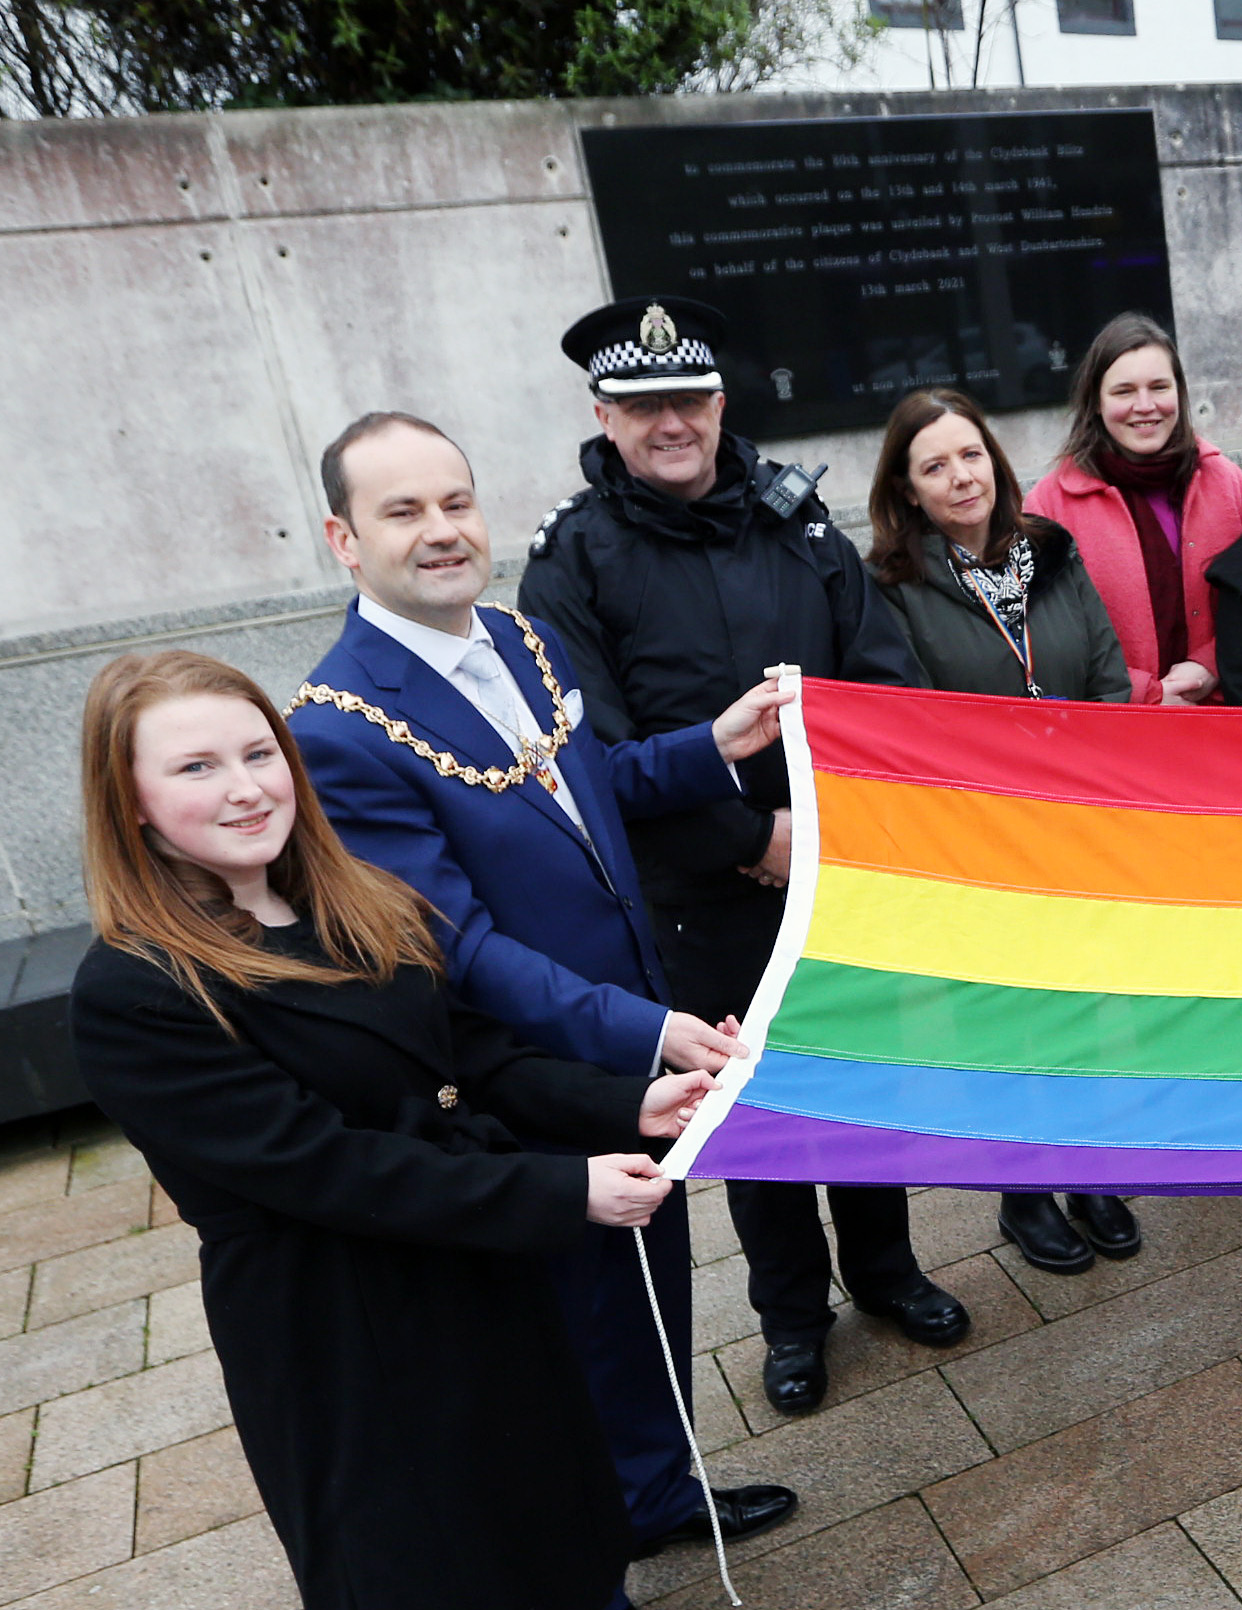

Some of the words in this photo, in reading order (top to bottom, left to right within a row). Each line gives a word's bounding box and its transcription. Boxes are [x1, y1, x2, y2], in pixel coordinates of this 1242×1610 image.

[707, 159, 797, 175] commemorate
[803, 157, 824, 168] the
[868, 152, 936, 166] anniversary
[944, 150, 957, 163] of
[964, 149, 983, 161] the
[990, 144, 1049, 161] Clydebank
[1057, 144, 1084, 157] Blitz
[728, 192, 766, 207] which
[775, 188, 829, 204] occurred
[837, 190, 853, 200] on
[861, 186, 880, 198] the
[889, 184, 915, 197] 13th
[922, 184, 944, 195] and
[952, 181, 977, 194] 14th
[984, 179, 1018, 192] march
[669, 232, 695, 246] this
[703, 225, 803, 244] commemorative
[811, 222, 852, 239] plaque
[861, 220, 884, 231] was
[891, 215, 942, 230] unveiled
[949, 214, 963, 228] by
[971, 210, 1014, 224] Provost
[1021, 208, 1064, 221] William
[689, 267, 706, 279] on
[714, 260, 755, 276] behalf
[763, 258, 777, 271] of
[785, 257, 805, 270] the
[813, 254, 860, 269] citizens
[868, 250, 881, 264] of
[889, 246, 950, 263] Clydebank
[958, 244, 979, 257] and
[986, 241, 1013, 254] West
[861, 283, 887, 296] 13th
[895, 278, 930, 293] march
[937, 276, 966, 290] 2021
